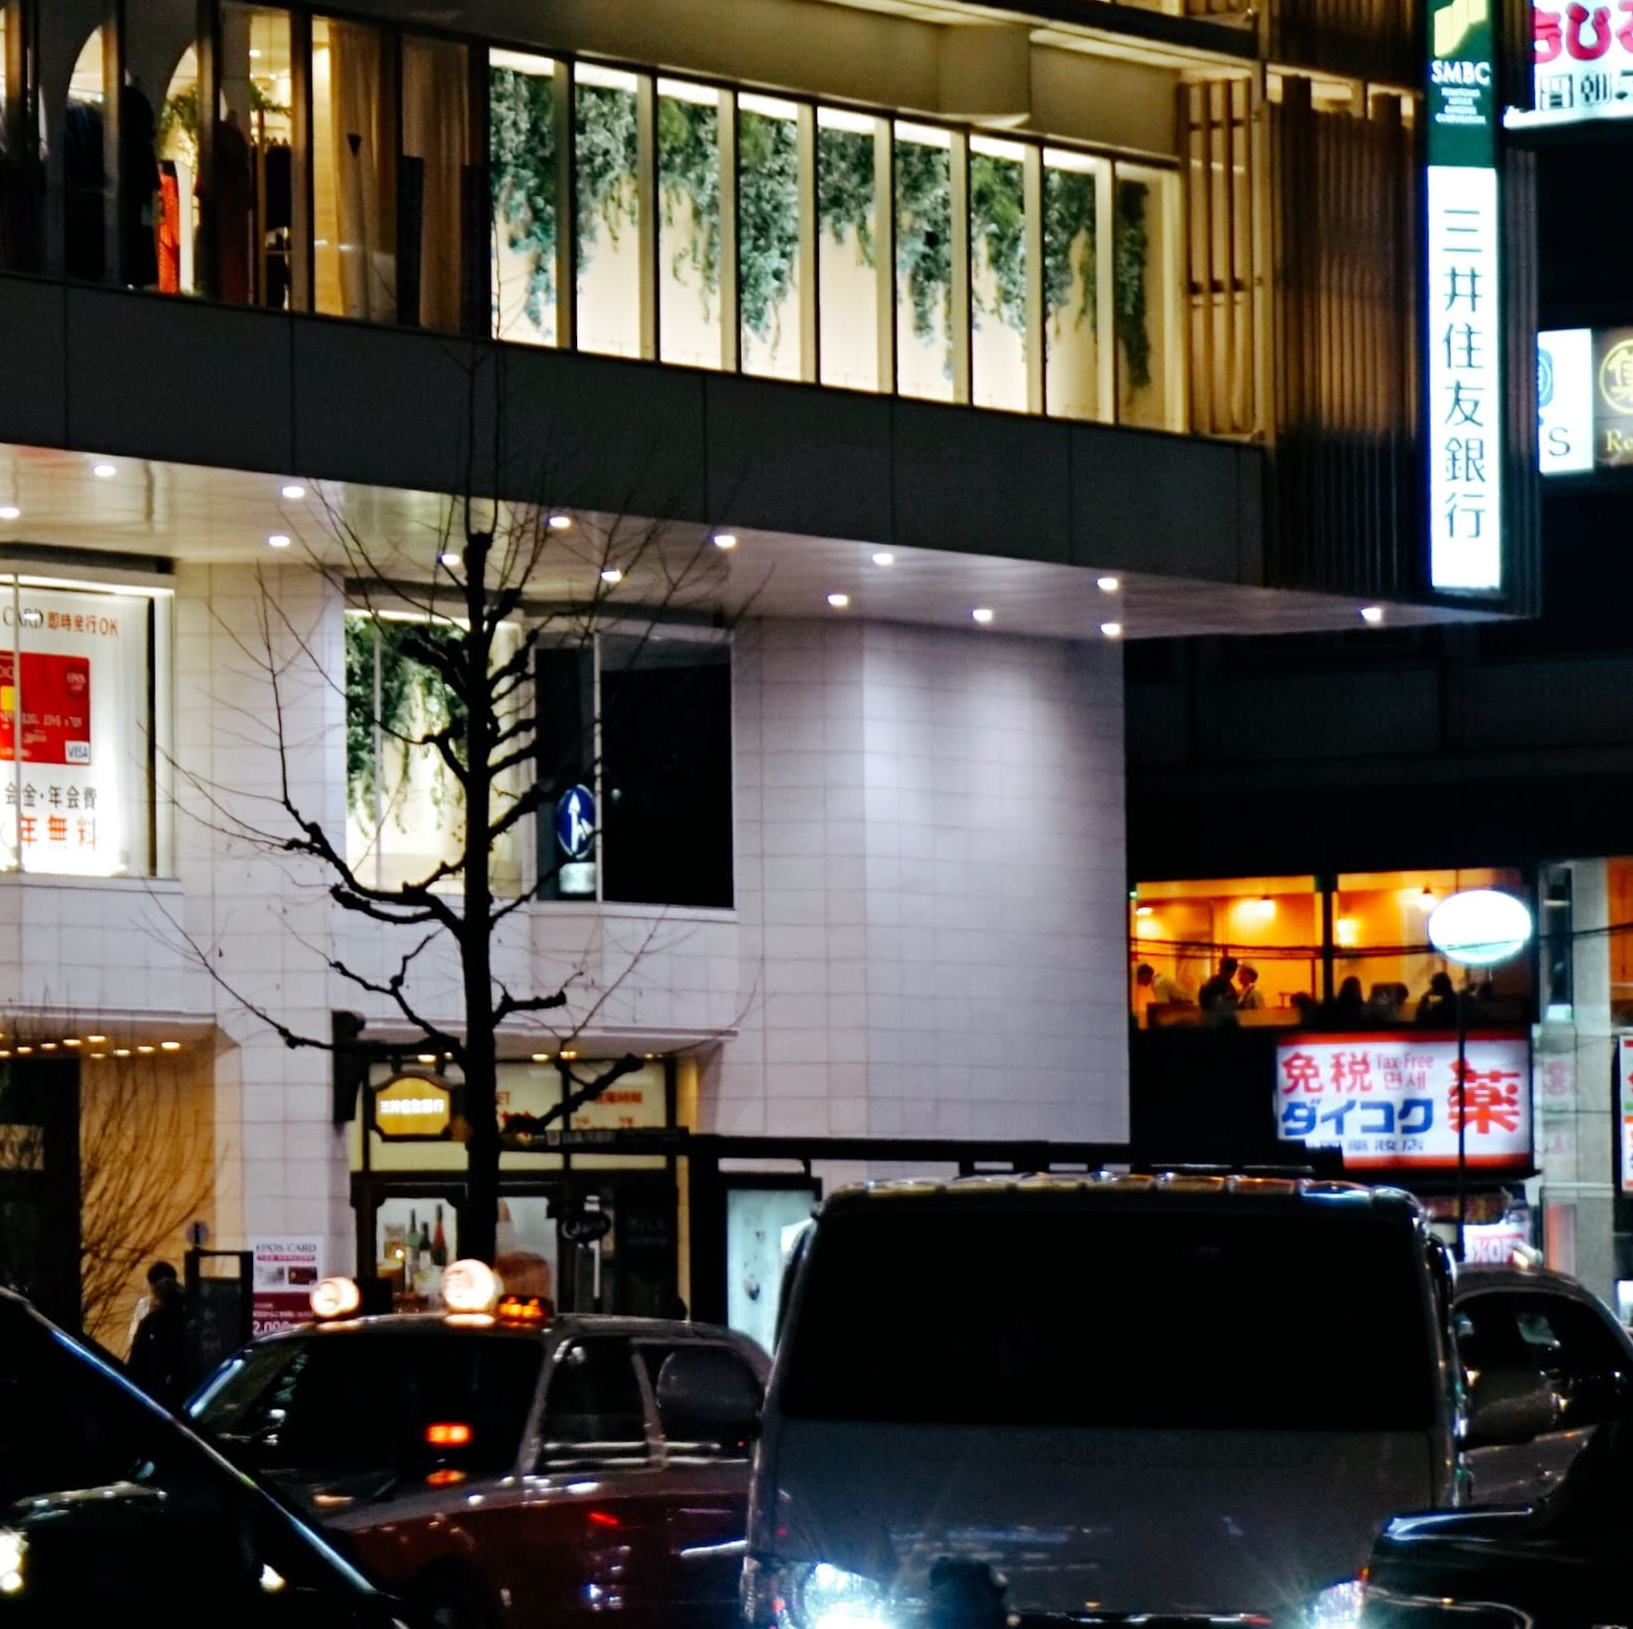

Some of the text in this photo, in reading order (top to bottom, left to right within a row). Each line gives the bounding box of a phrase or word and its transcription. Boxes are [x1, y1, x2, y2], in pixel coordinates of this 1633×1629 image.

[1431, 60, 1491, 86] SMBC
[1441, 208, 1487, 539] 三井住友銀行
[67, 745, 89, 759] VISA
[1281, 1051, 1373, 1094] 免税
[1447, 1058, 1521, 1135] 薬
[1281, 1097, 1434, 1137] ダイコク
[286, 1242, 317, 1253] CARD
